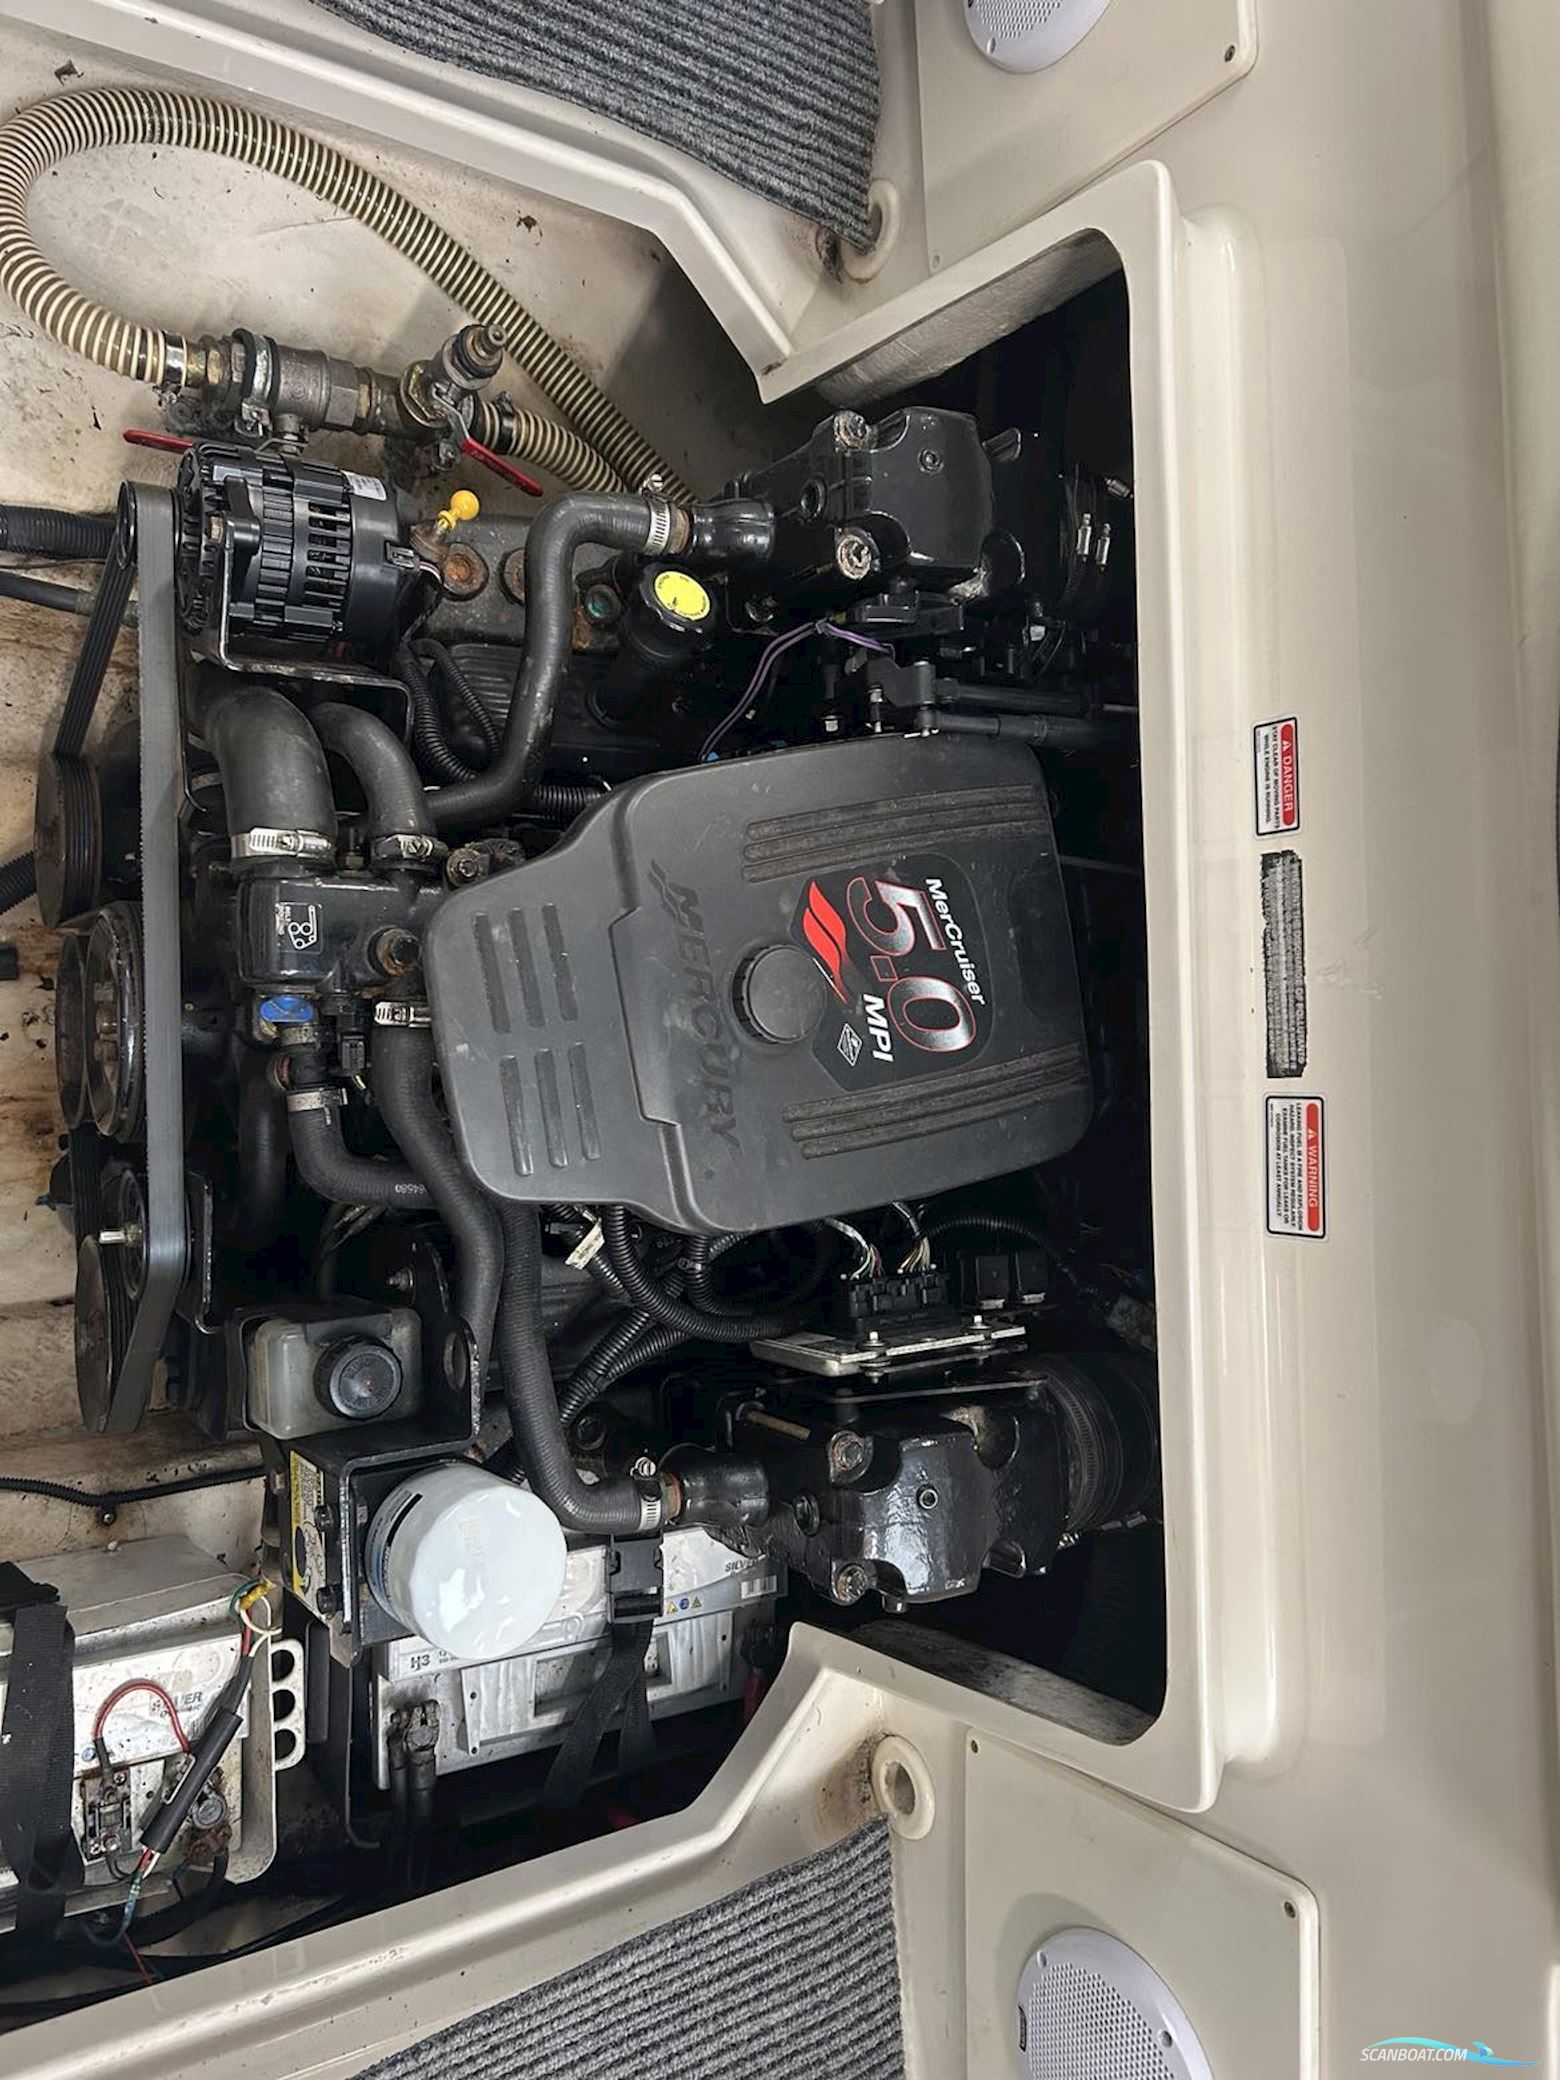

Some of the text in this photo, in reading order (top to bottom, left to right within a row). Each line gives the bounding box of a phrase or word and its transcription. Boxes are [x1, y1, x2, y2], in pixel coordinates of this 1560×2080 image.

[1274, 768, 1279, 777] OF
[1283, 755, 1293, 812] DANGER
[846, 877, 977, 1052] 5.0
[925, 878, 985, 1006] MerCruiser
[652, 864, 742, 1156] MERCURY
[1295, 987, 1304, 1001] OF
[863, 993, 894, 1062] MPI
[1276, 1152, 1281, 1160] AT
[1308, 1145, 1318, 1207] WARNING
[1284, 1214, 1289, 1224] OR
